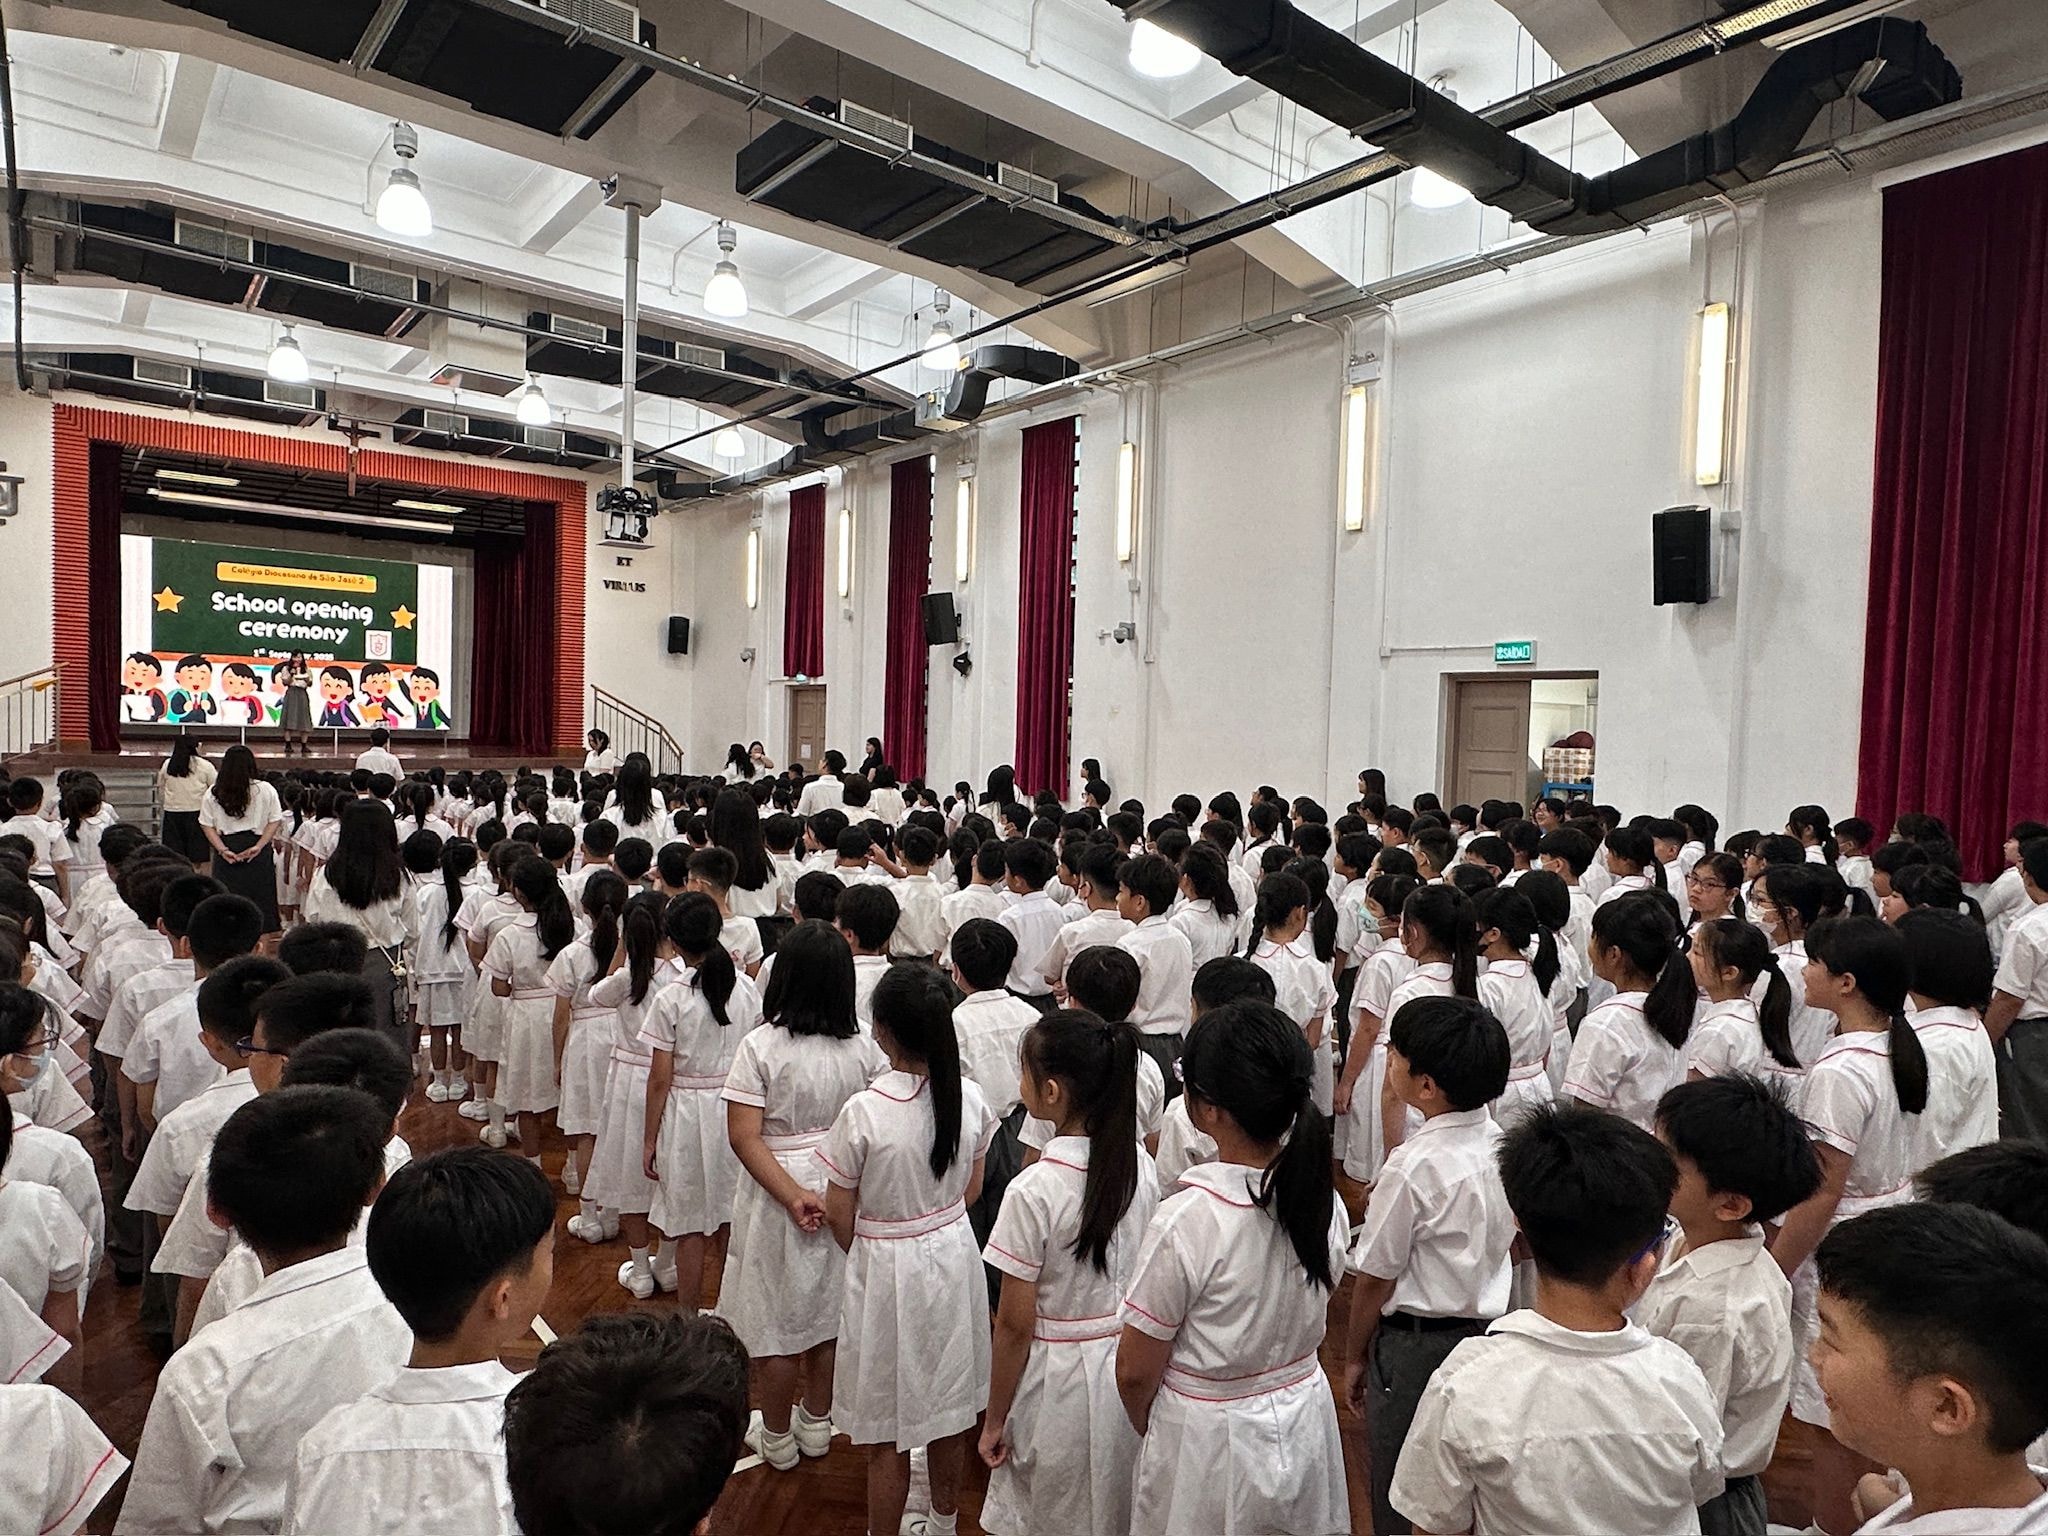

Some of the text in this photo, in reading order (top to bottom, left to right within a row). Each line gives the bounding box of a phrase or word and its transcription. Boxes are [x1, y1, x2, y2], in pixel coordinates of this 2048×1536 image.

[616, 556, 633, 567] ET
[308, 573, 317, 581] de
[358, 577, 365, 585] 2
[211, 591, 374, 627] School opening
[238, 620, 350, 645] ceremony
